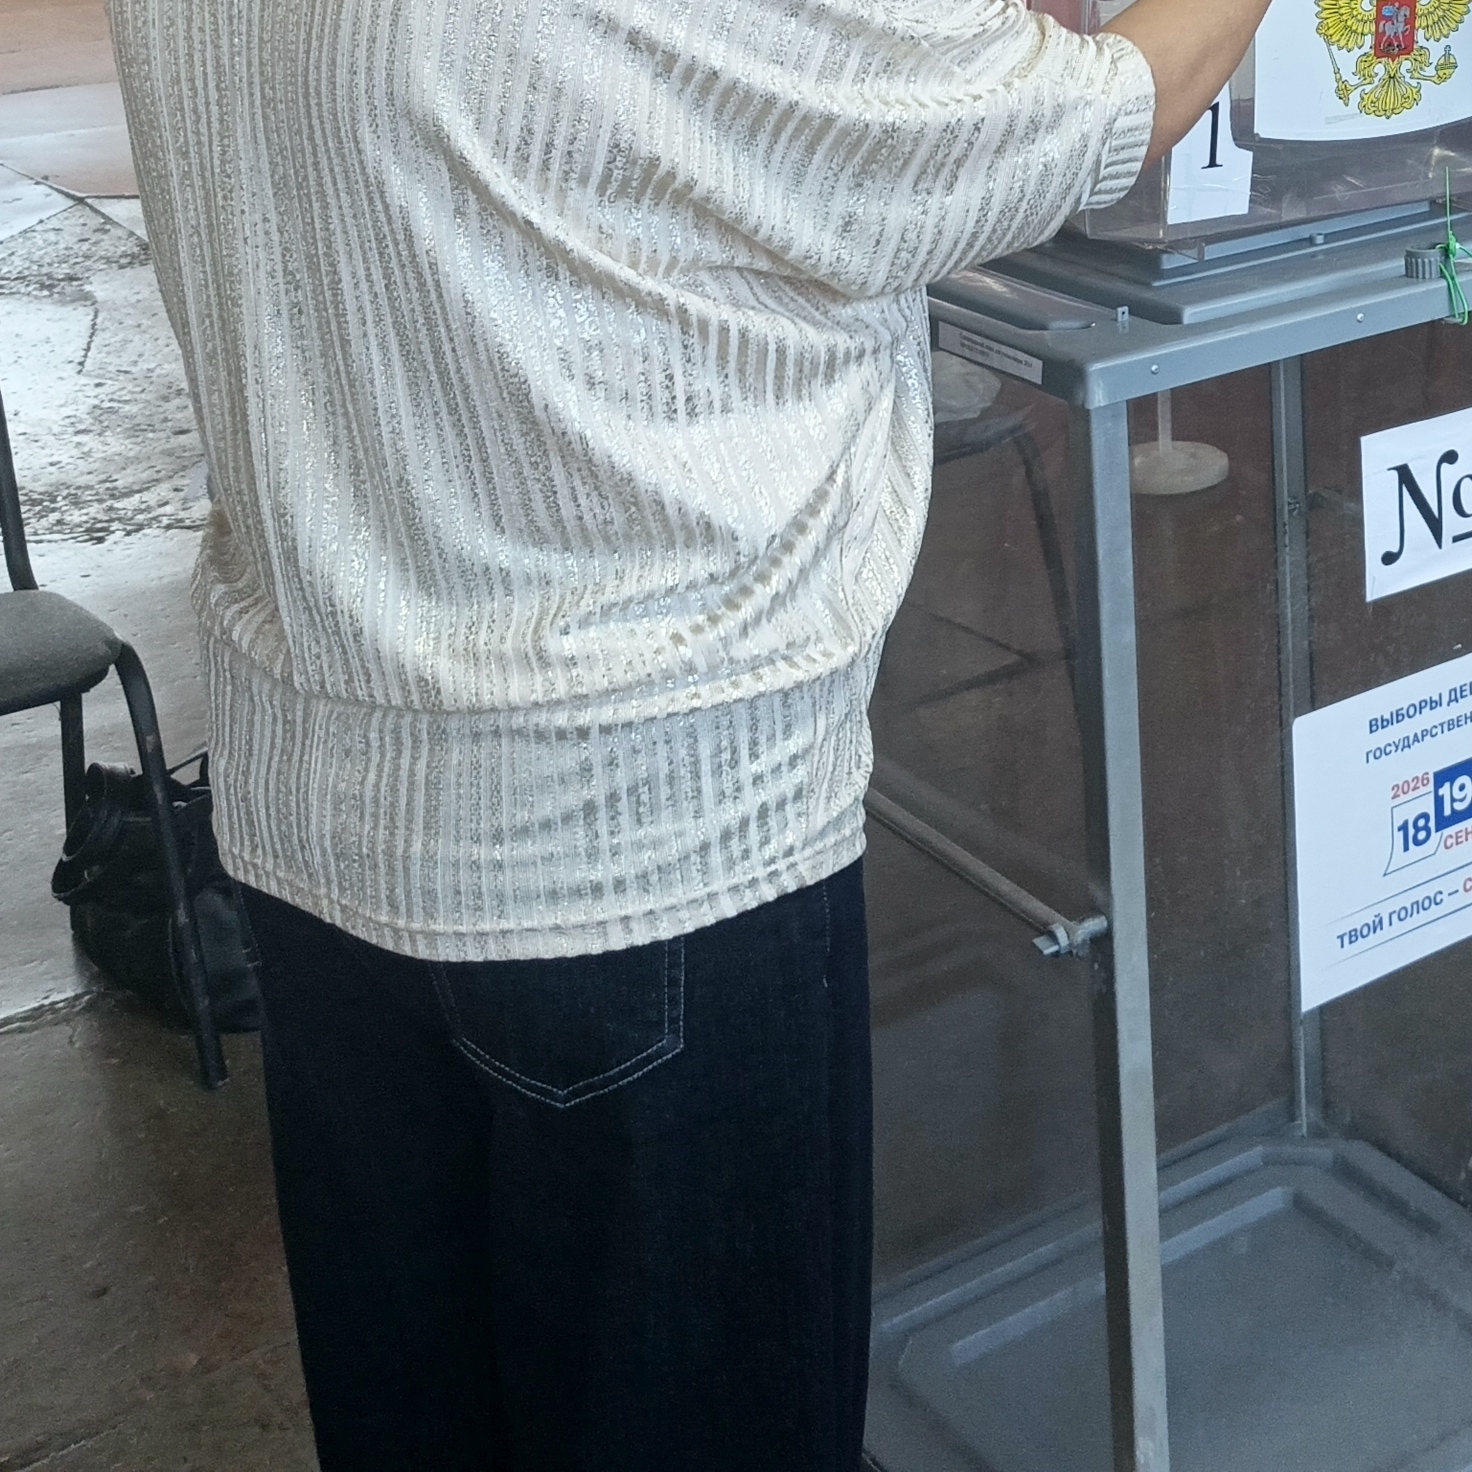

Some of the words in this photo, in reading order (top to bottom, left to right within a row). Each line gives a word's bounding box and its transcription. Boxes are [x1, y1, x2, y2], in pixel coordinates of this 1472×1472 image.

[1368, 692, 1443, 735] ВЫБОРЫ
[1390, 771, 1430, 800] 2026
[1397, 811, 1432, 853] 18
[1438, 774, 1472, 818] 19
[1336, 913, 1384, 949] ТВОЙ
[1388, 890, 1444, 927] ГОЛОС
